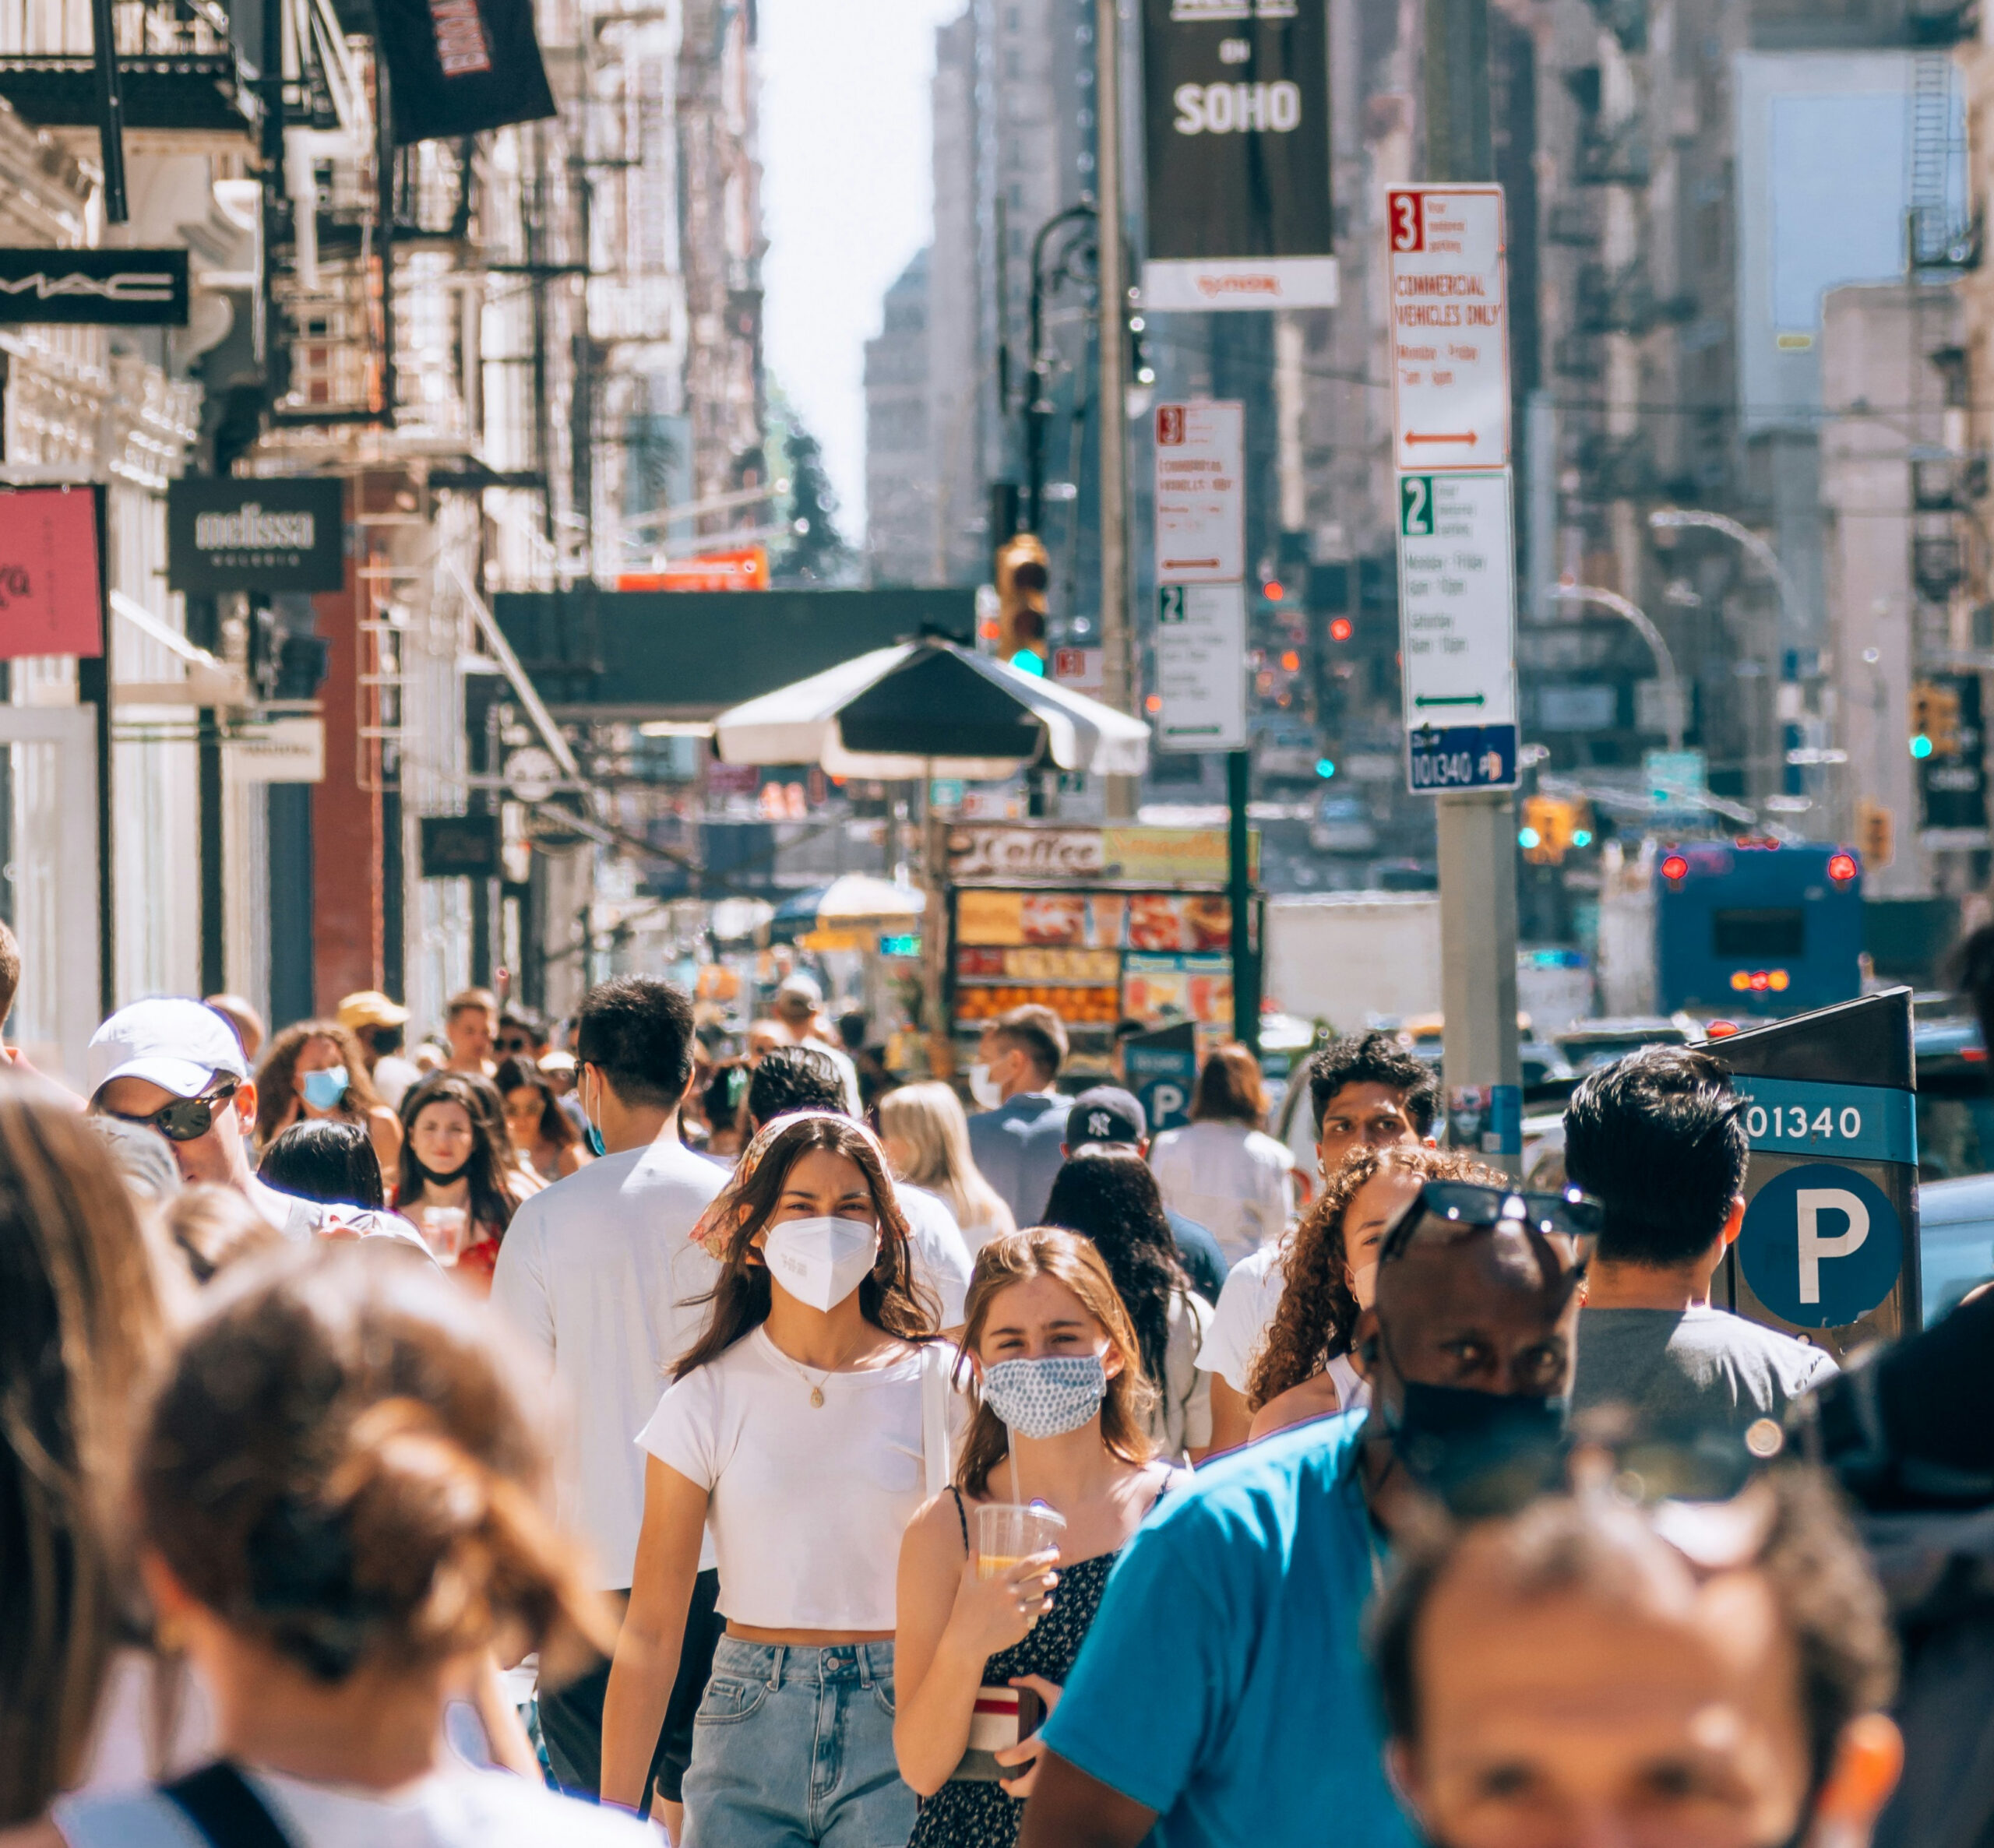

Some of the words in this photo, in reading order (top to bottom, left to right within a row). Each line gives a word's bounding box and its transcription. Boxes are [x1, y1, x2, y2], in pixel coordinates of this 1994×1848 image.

[1174, 80, 1301, 135] SOHO
[1396, 195, 1417, 251] 3
[1397, 274, 1485, 297] COMMERCIAL
[1396, 304, 1461, 326] VEHICLES
[1465, 304, 1501, 326] ONLY
[196, 501, 315, 550] melissa
[1405, 477, 1427, 534] 2
[1164, 589, 1179, 621] 2
[981, 835, 1098, 862] Coffee
[1153, 1083, 1183, 1127] P
[1796, 1188, 1870, 1304] P
